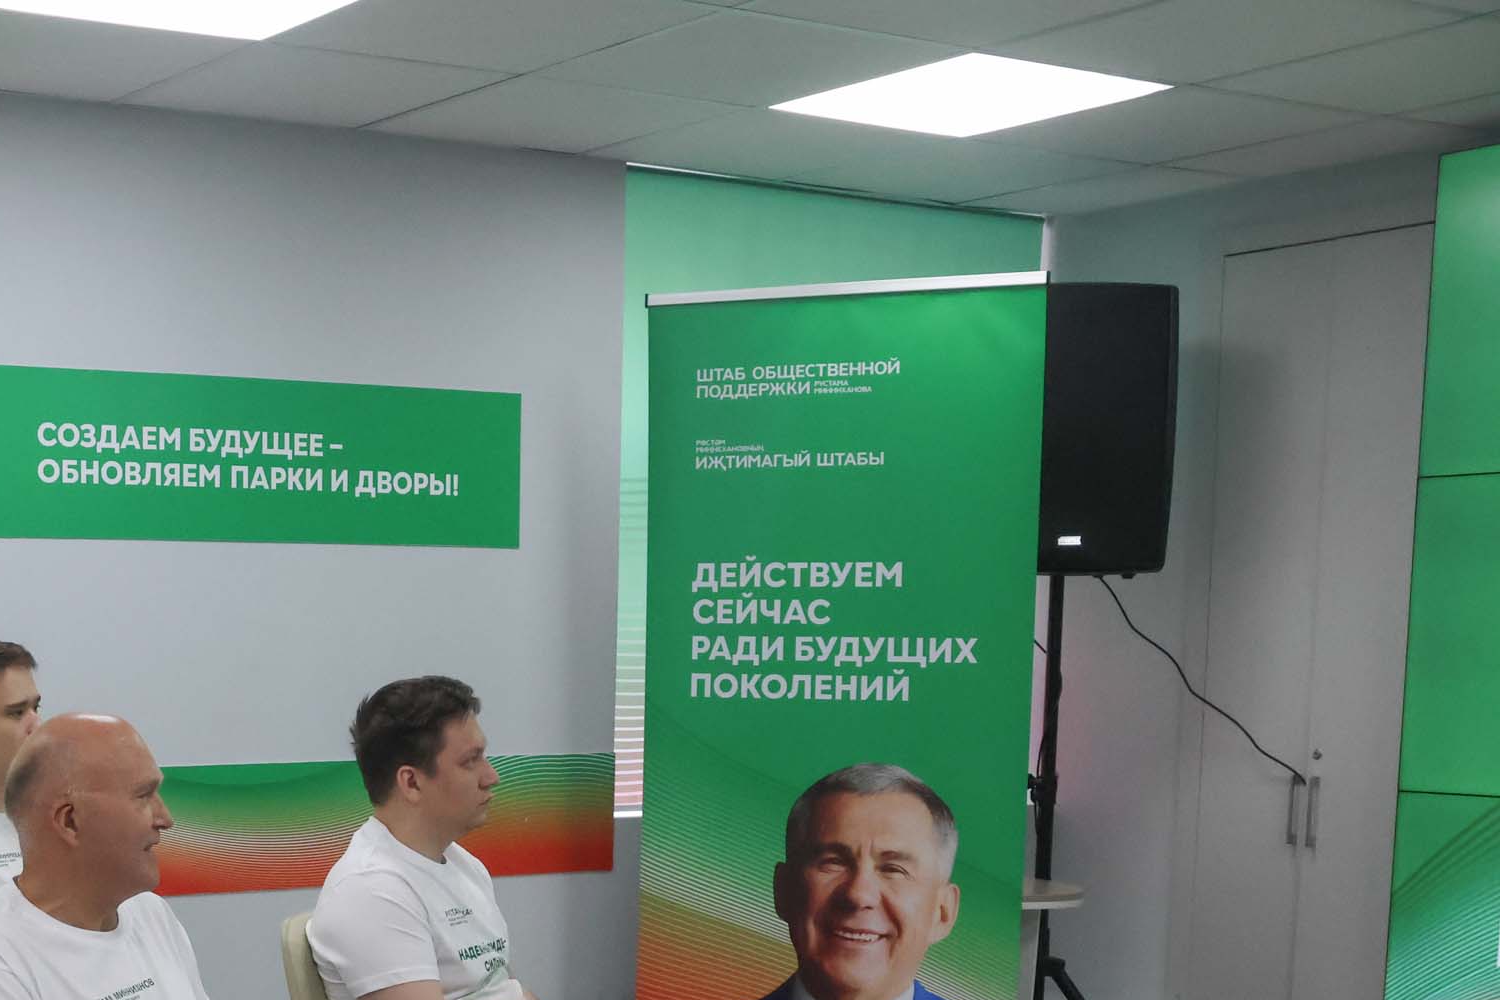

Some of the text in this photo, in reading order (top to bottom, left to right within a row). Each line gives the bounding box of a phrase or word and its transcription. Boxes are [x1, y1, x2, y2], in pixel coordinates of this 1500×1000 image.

[696, 358, 900, 382] ШТАБ ОБЩЕСТВЕННОЙ
[695, 381, 811, 400] ПОДДЕРЖКИ
[37, 422, 181, 453] СОЗДАЕМ
[189, 428, 324, 460] БУДУЩЕЕ
[695, 450, 885, 471] ИҖТИМАГЫЙ ШТАБЫ
[37, 459, 459, 498] ОБНОВЛЯЕМ ПАРКИ И ДВОРЫ!
[691, 555, 903, 592] ДЕЙСТВУЕМ
[692, 592, 831, 625] СЕЙЧАС
[691, 635, 978, 668] РАДИ БУДУЩИХ
[690, 668, 910, 702] ПОКОЛЕНИЙ
